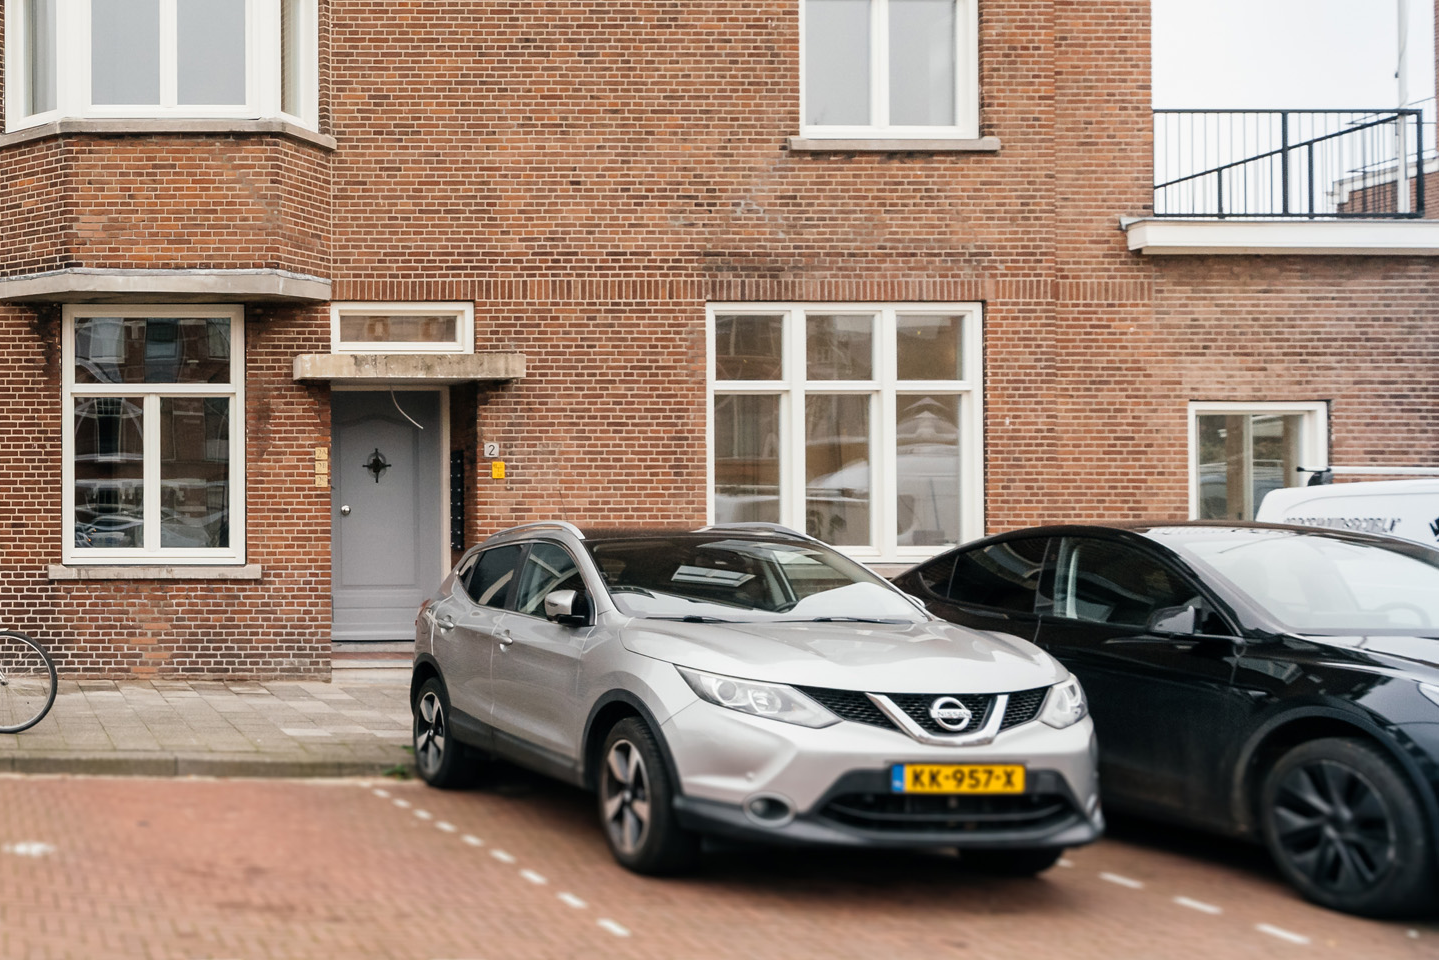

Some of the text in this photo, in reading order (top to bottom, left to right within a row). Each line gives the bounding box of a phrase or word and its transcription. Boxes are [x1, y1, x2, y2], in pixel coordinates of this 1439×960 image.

[488, 444, 496, 456] 2
[937, 710, 972, 718] NISSAN
[911, 768, 1017, 790] KK-957-X
